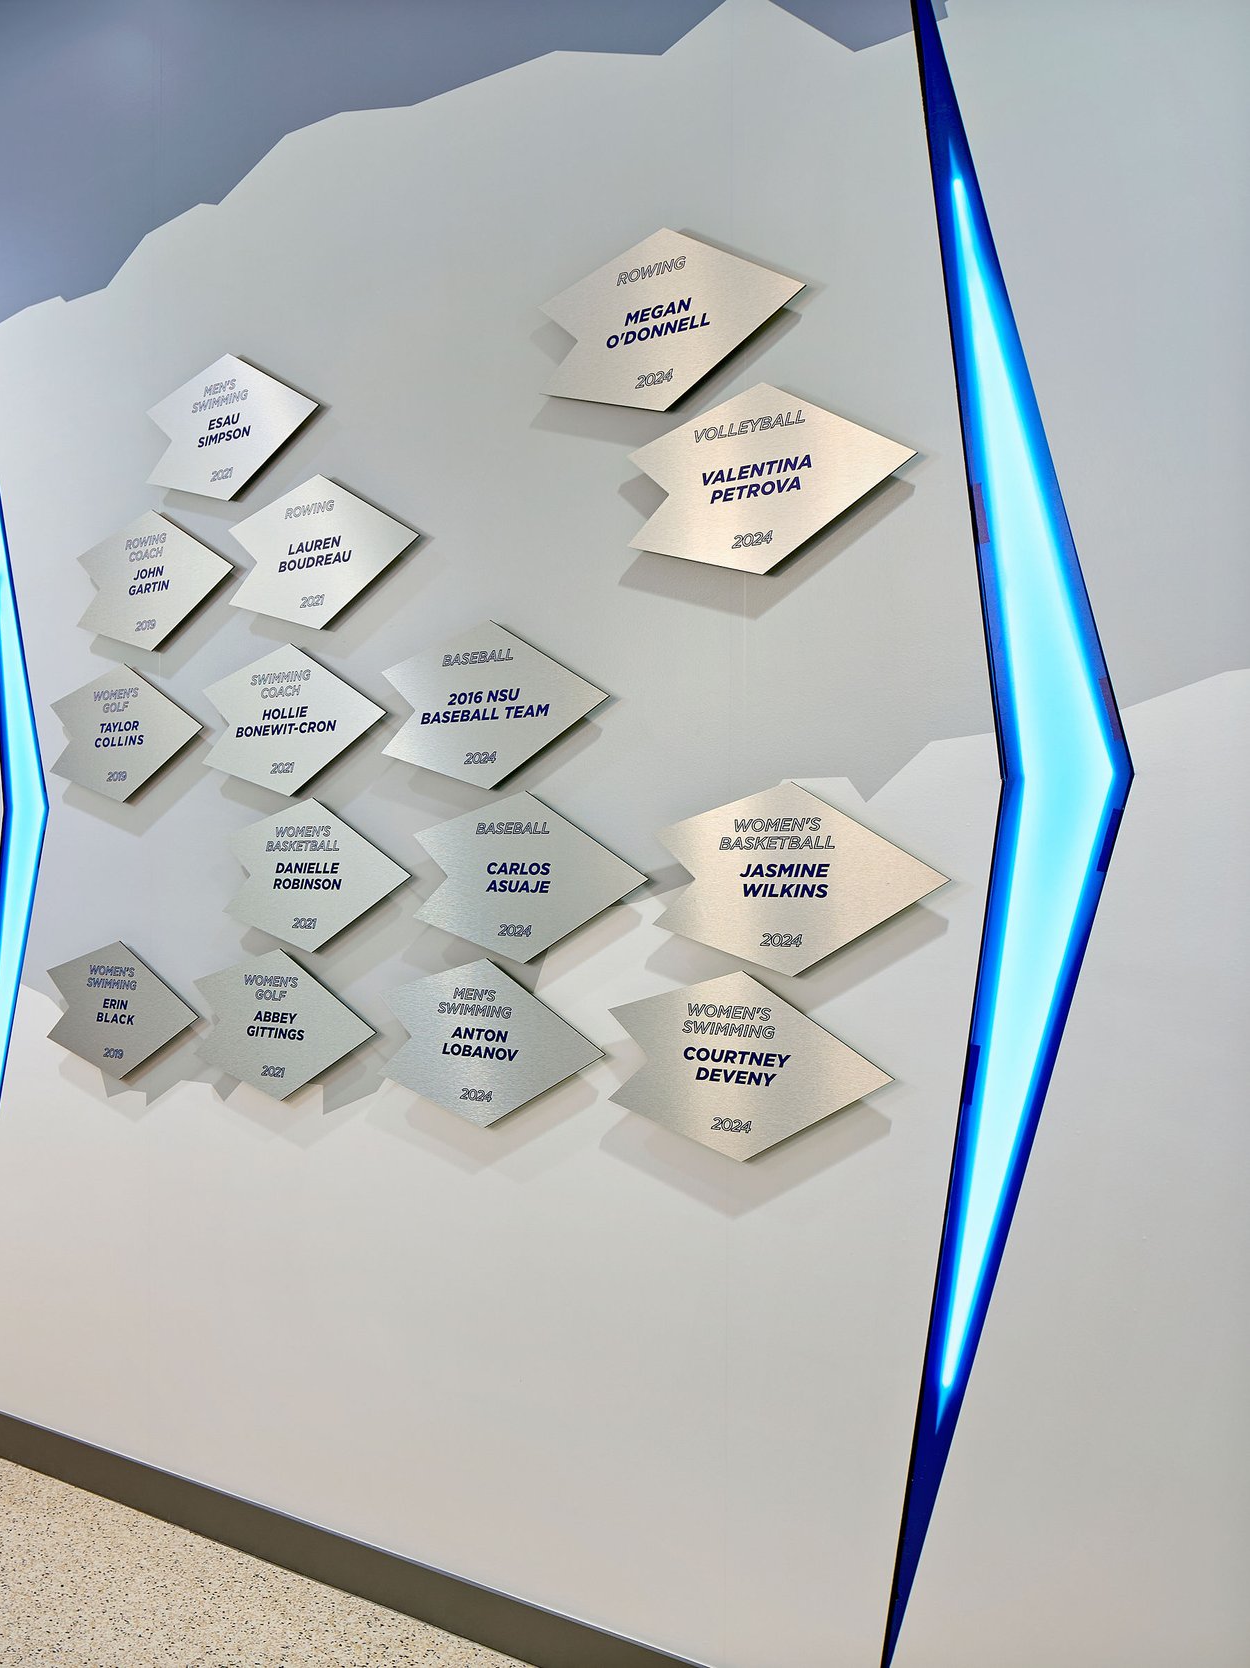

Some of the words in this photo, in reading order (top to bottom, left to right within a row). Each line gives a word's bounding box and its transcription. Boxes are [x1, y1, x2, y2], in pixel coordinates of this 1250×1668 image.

[617, 255, 686, 286] ROWING
[624, 297, 692, 327] MEGAN
[606, 312, 710, 349] O'DONNELL
[635, 368, 673, 389] 2024
[203, 378, 236, 398] MEN'S
[192, 388, 248, 414] SWIMMING
[208, 413, 240, 431] ESAU
[694, 409, 806, 443] VOLLEYBALL
[198, 425, 251, 448] SIMPSON
[210, 467, 233, 482] 2021
[701, 454, 812, 487] VALENTINA
[710, 476, 801, 504] PETROVA
[284, 500, 335, 520] ROWING
[125, 533, 166, 550] ROWING
[288, 536, 341, 556] LAUREN
[732, 530, 773, 549] 2024
[128, 547, 163, 562] COACH
[278, 550, 352, 573] BOUDREAU
[133, 566, 164, 581] JOHN
[128, 580, 170, 596] GARTIN
[300, 594, 325, 609] 2021
[135, 619, 156, 632] 2019
[442, 649, 514, 667] BASEBALL
[250, 669, 311, 686] SWIMMING
[93, 687, 139, 702] WOMEN'S
[260, 685, 301, 699] COACH
[448, 691, 483, 706] 2016
[486, 688, 520, 702] NSU
[102, 701, 129, 714] GOLF
[262, 706, 308, 720] HOLLIE
[421, 708, 499, 725] BASEBALL
[504, 704, 550, 719] TEAM
[100, 721, 140, 734] TAYLOR
[236, 720, 337, 738] BONEWIT-CRON
[94, 734, 144, 748] COLLINS
[464, 751, 497, 765] 2024
[270, 762, 295, 774] 2021
[106, 771, 127, 782] 2019
[275, 826, 331, 838] WOMEN'S
[476, 822, 550, 835] BASEBALL
[733, 817, 822, 833] WOMEN'S
[265, 840, 340, 852] BASKETBALL
[719, 835, 835, 851] BASKETBALL
[275, 862, 340, 874] DANIELLE
[486, 862, 551, 876] CARLOS
[740, 863, 830, 878] JASMINE
[273, 878, 342, 890] ROBINSON
[486, 880, 551, 894] ASUAJE
[742, 884, 828, 898] WILKINS
[292, 917, 317, 929] 2021
[498, 924, 532, 937] 2024
[760, 932, 802, 948] 2024
[89, 964, 135, 978] WOMEN'S
[86, 977, 137, 991] SWIMMING
[244, 974, 299, 988] WOMEN'S
[255, 989, 287, 1002] GOLF
[453, 987, 497, 1002] MEN'S
[102, 998, 128, 1010] ERIN
[437, 1002, 512, 1019] SWIMMING
[96, 1012, 135, 1026] BLACK
[253, 1011, 297, 1024] ABBEY
[687, 1003, 772, 1022] WOMEN'S
[246, 1026, 305, 1041] GITTINGS
[451, 1027, 509, 1043] ANTON
[682, 1021, 775, 1040] SWIMMING
[103, 1047, 123, 1059] 2019
[442, 1043, 519, 1061] LOBANOV
[683, 1046, 791, 1068] COURTNEY
[260, 1065, 285, 1079] 2021
[695, 1067, 777, 1087] DEVENY
[459, 1088, 493, 1102] 2024
[711, 1117, 752, 1133] 2024
